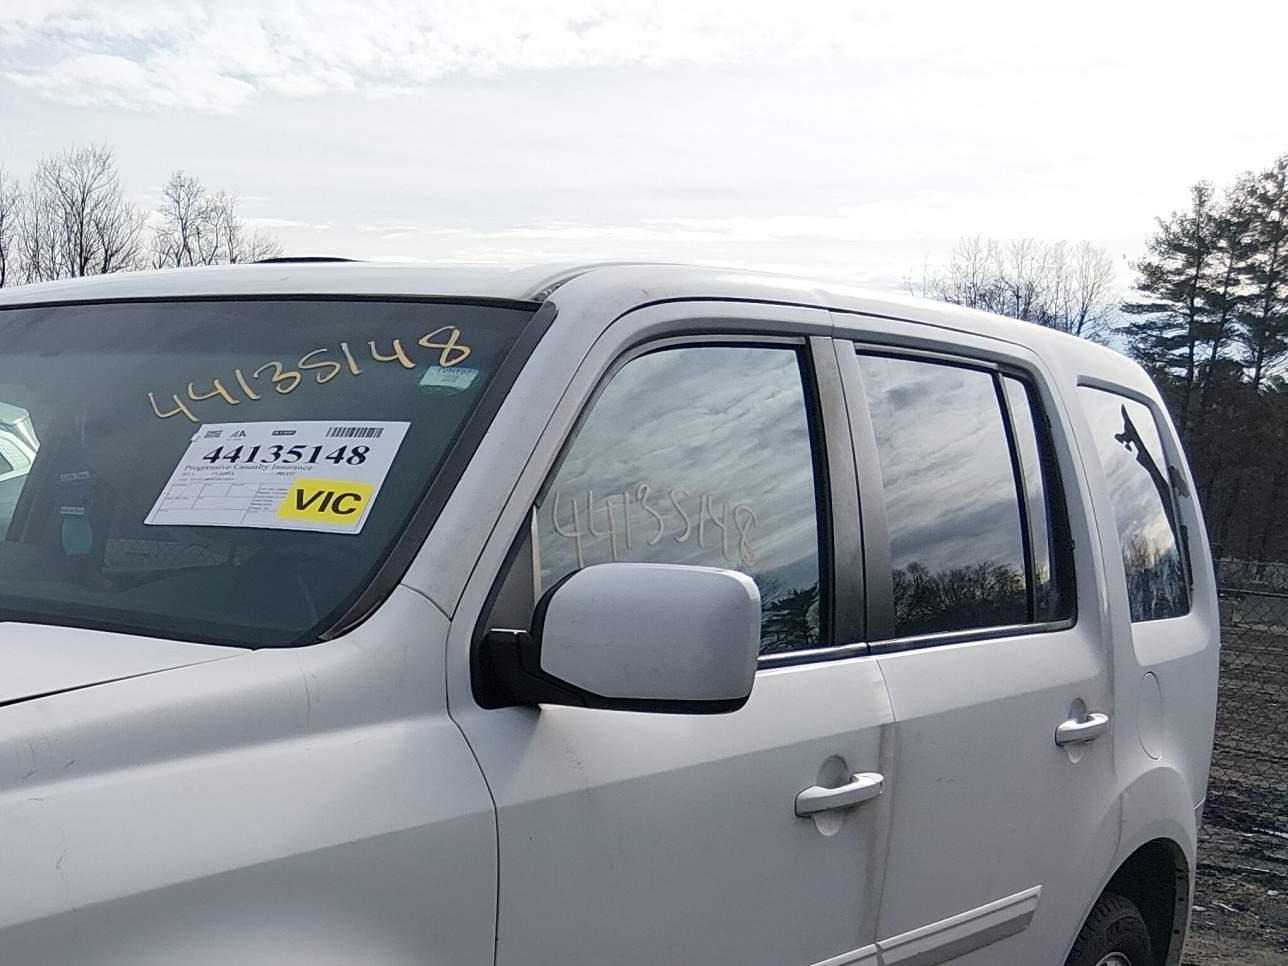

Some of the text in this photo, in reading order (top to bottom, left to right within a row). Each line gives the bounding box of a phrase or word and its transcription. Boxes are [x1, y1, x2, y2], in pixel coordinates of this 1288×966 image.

[148, 325, 471, 423] 44135148
[202, 444, 370, 466] 44135148
[233, 463, 268, 471] Casualty
[272, 463, 314, 471] Insurance
[296, 488, 362, 515] VIC
[551, 483, 758, 569] 44135148
